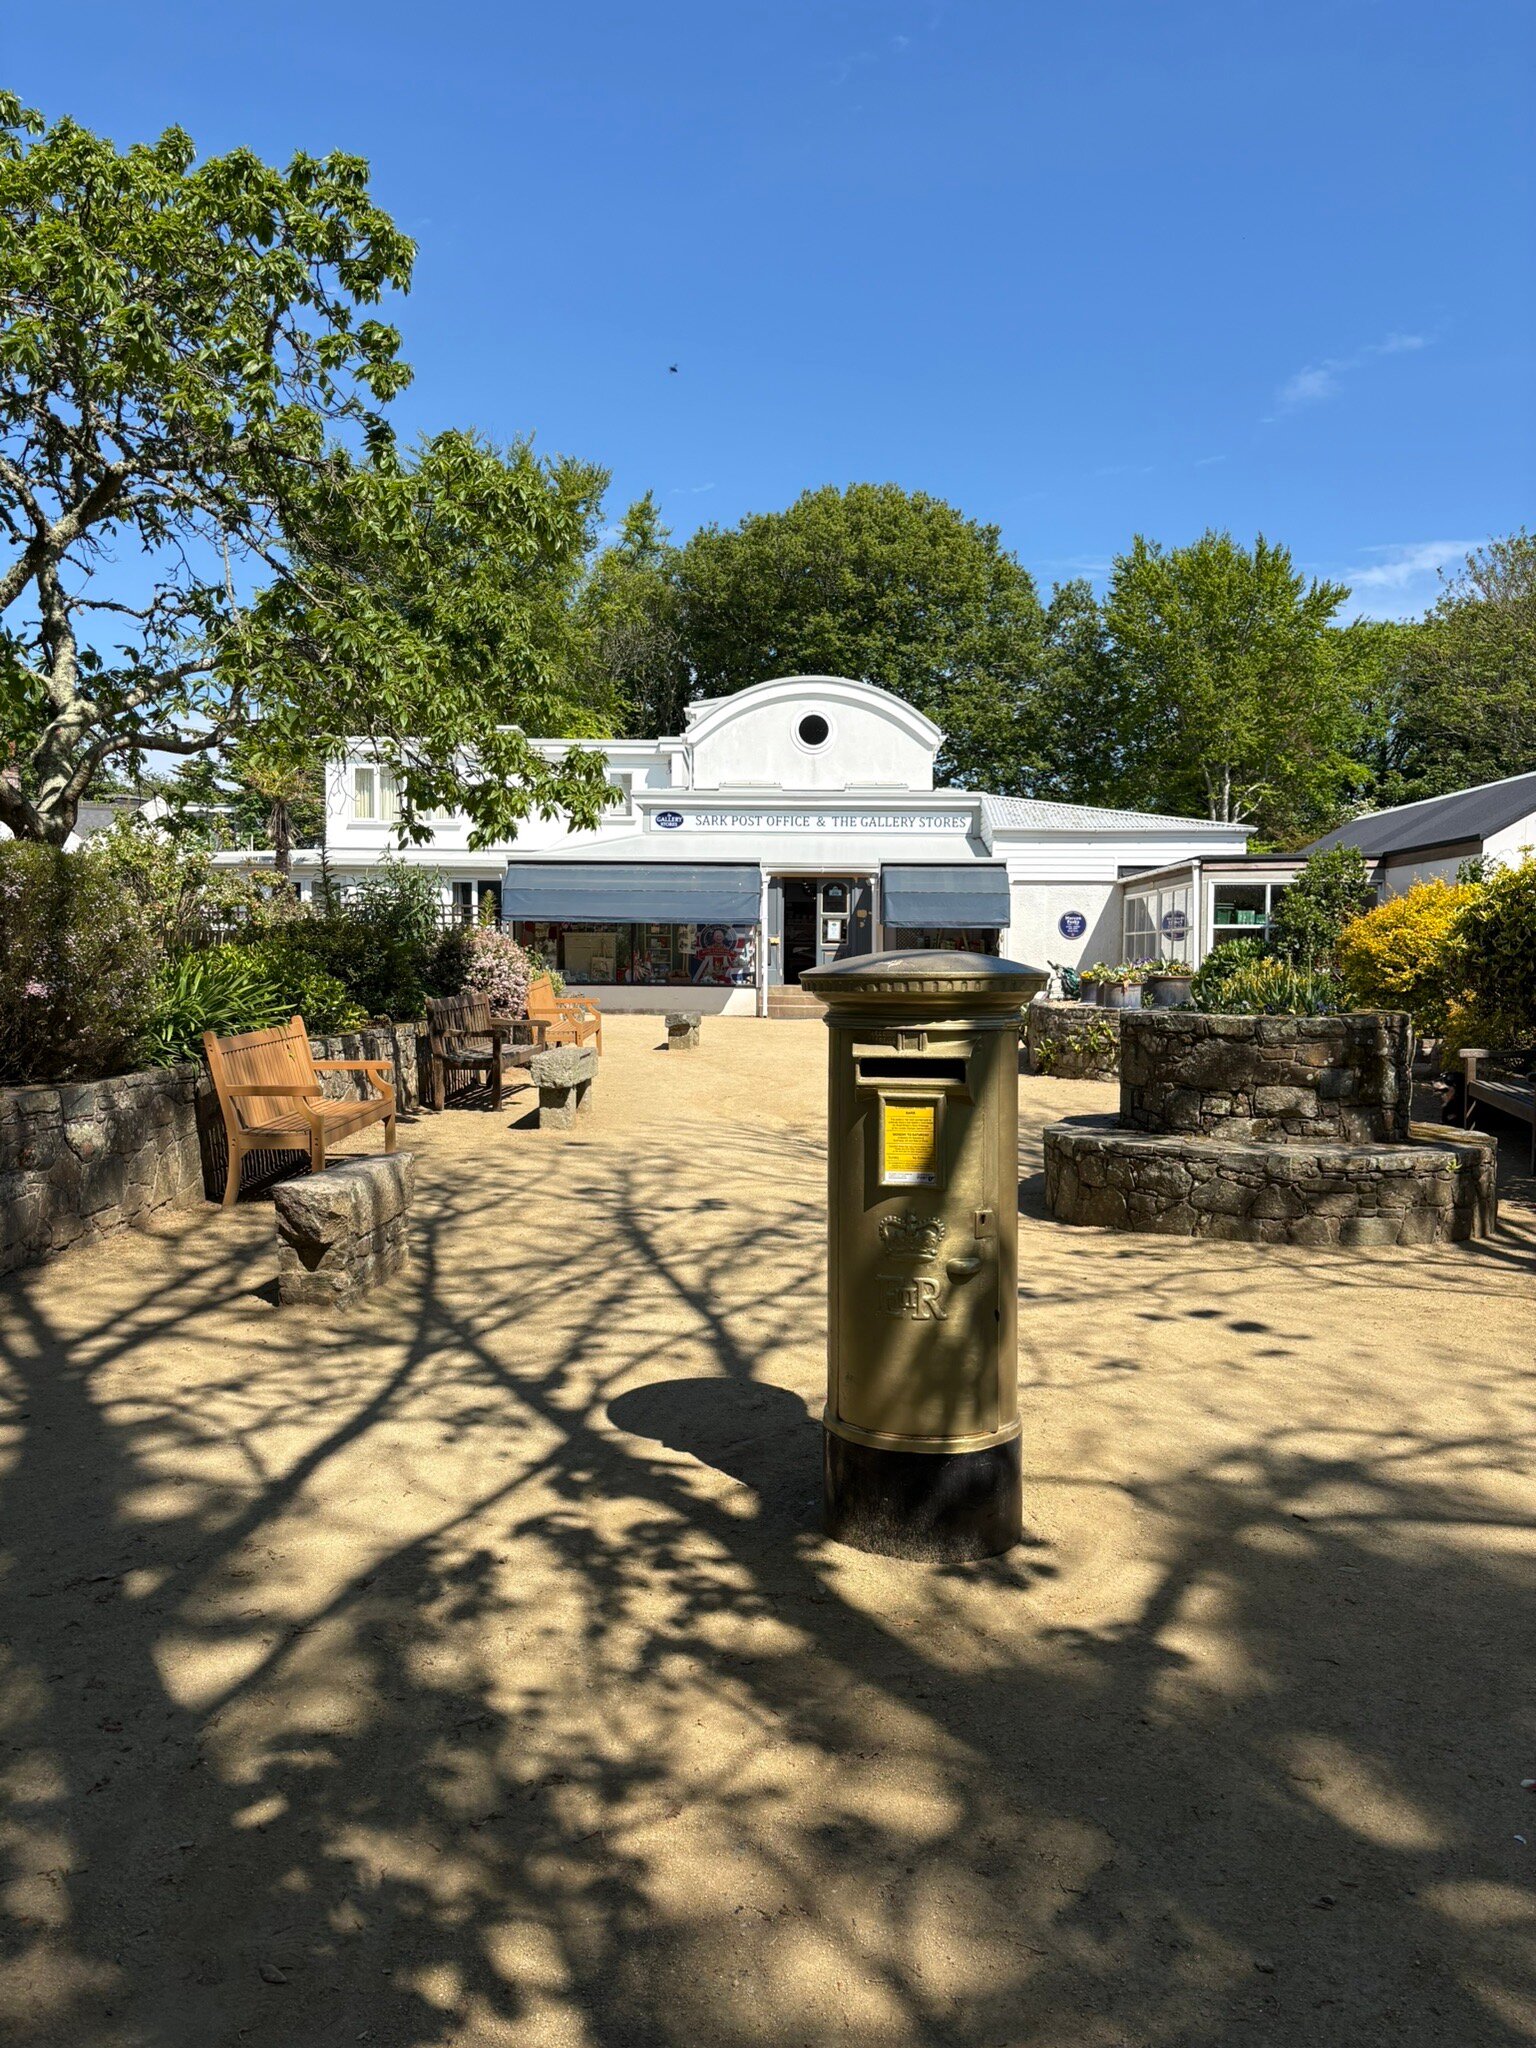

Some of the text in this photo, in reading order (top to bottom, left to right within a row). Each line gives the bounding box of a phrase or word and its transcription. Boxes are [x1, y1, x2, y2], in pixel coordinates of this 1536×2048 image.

[695, 815, 966, 828] SARK POST OFFICE & THE GALLERY STORES
